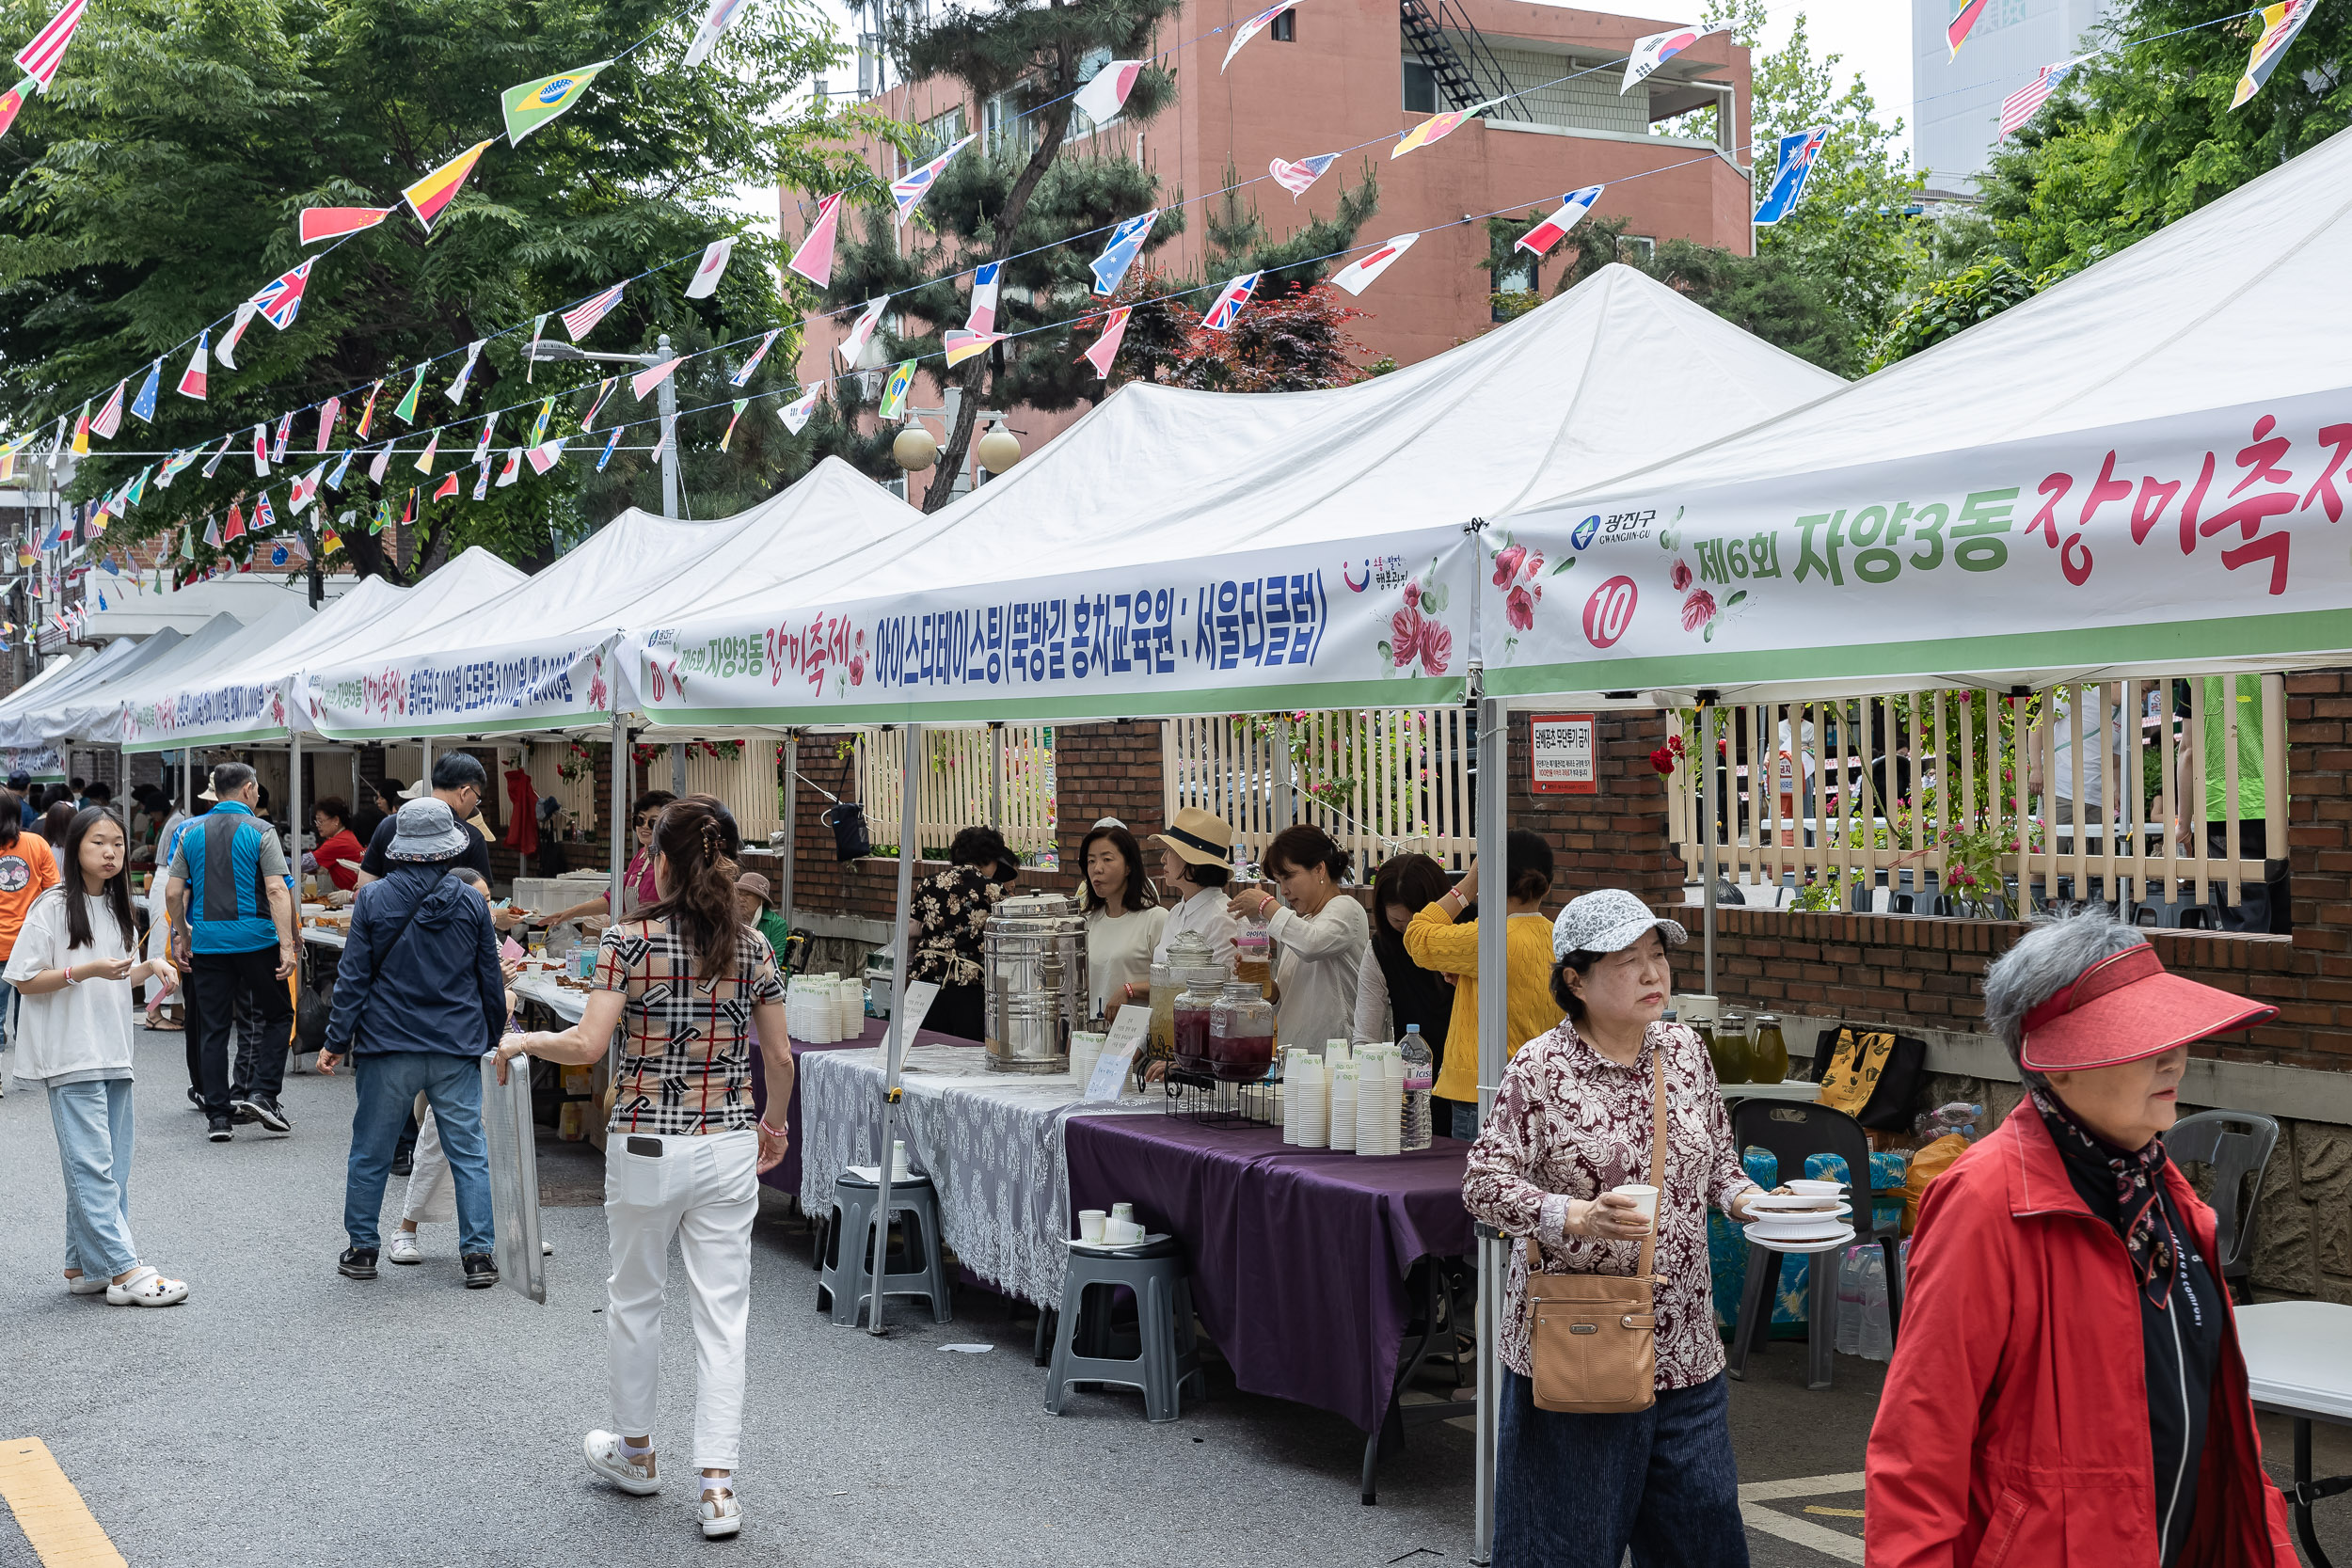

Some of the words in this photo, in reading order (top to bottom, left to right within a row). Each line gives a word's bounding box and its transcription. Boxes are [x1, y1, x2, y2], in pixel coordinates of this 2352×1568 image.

[1599, 530, 1650, 545] GWANGJIN-GU
[1605, 509, 1656, 533] 광진구
[1694, 531, 1783, 585] 제6회
[1792, 486, 2021, 586] 자양3동
[1375, 570, 1408, 591] 행복광진
[1592, 583, 1632, 641] 10
[676, 646, 706, 673] 제6회
[705, 633, 764, 678] 자양3동
[766, 610, 851, 698] 장미축제
[875, 599, 1066, 689] 아이스티테이스팅(뚝방길
[1071, 587, 1175, 679] 홍차교육원
[1195, 567, 1327, 671] 서울티클럽)
[335, 679, 362, 709] 자양3동
[408, 667, 435, 716] 홍어무침
[1535, 728, 1556, 749] 담배꽁초
[1557, 728, 1578, 749] 무단투기
[1579, 728, 1590, 749] 금지
